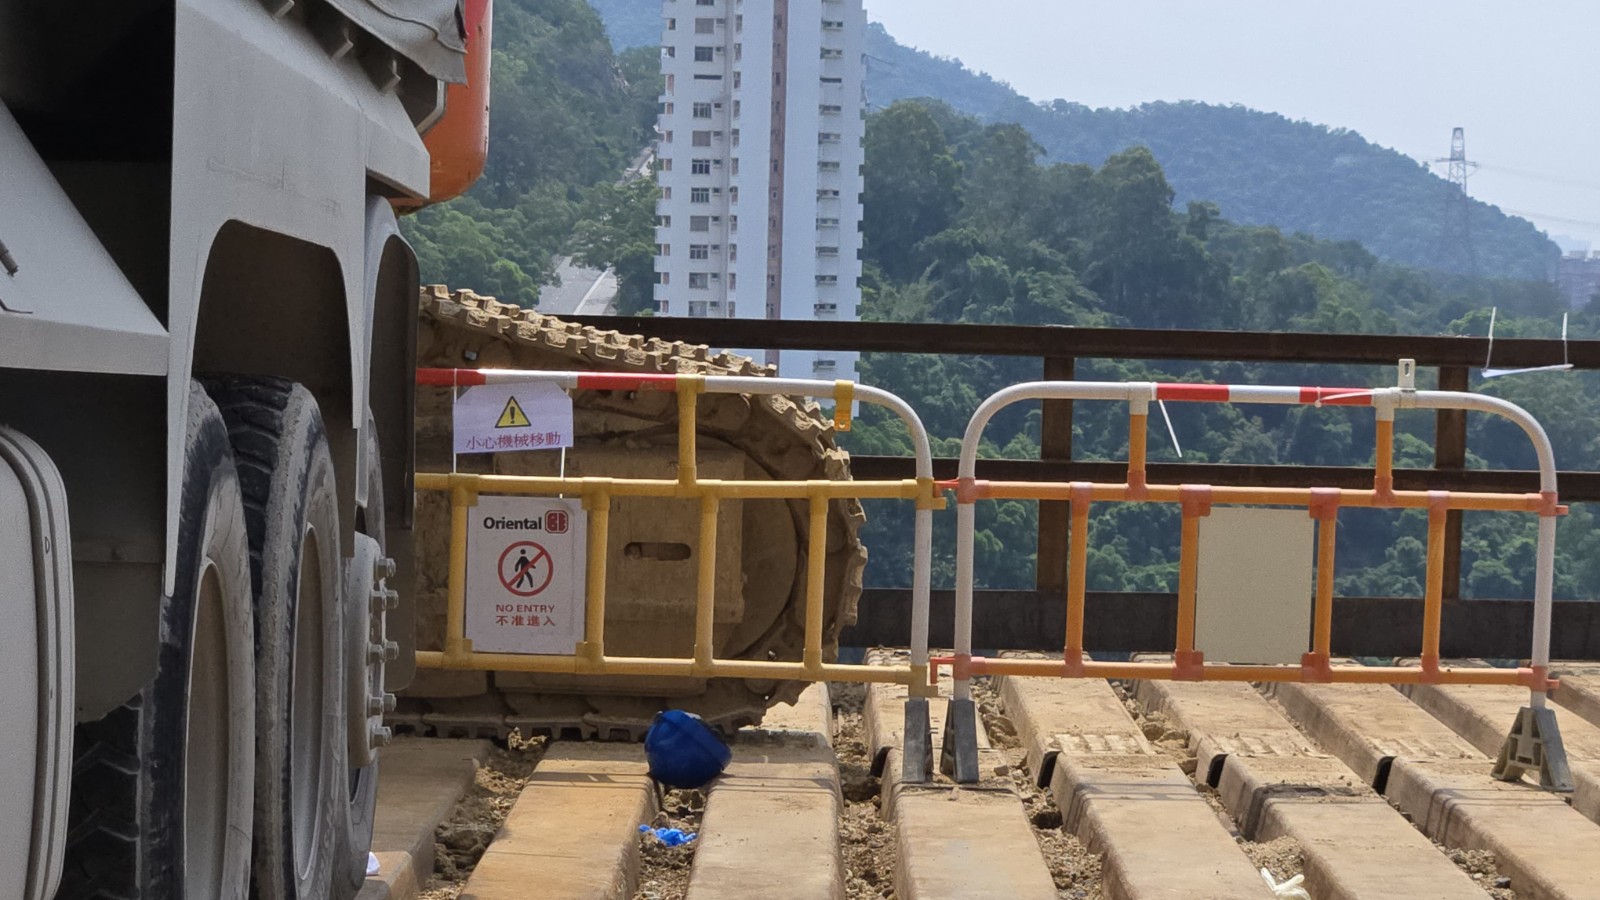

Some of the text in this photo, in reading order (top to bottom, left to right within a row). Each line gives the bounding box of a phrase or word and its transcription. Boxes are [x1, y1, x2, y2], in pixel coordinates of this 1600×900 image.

[465, 431, 561, 450] 小心機械移動
[483, 516, 542, 530] Oriental
[496, 604, 555, 613] NO ENTRY
[495, 615, 555, 626] 不准進入
